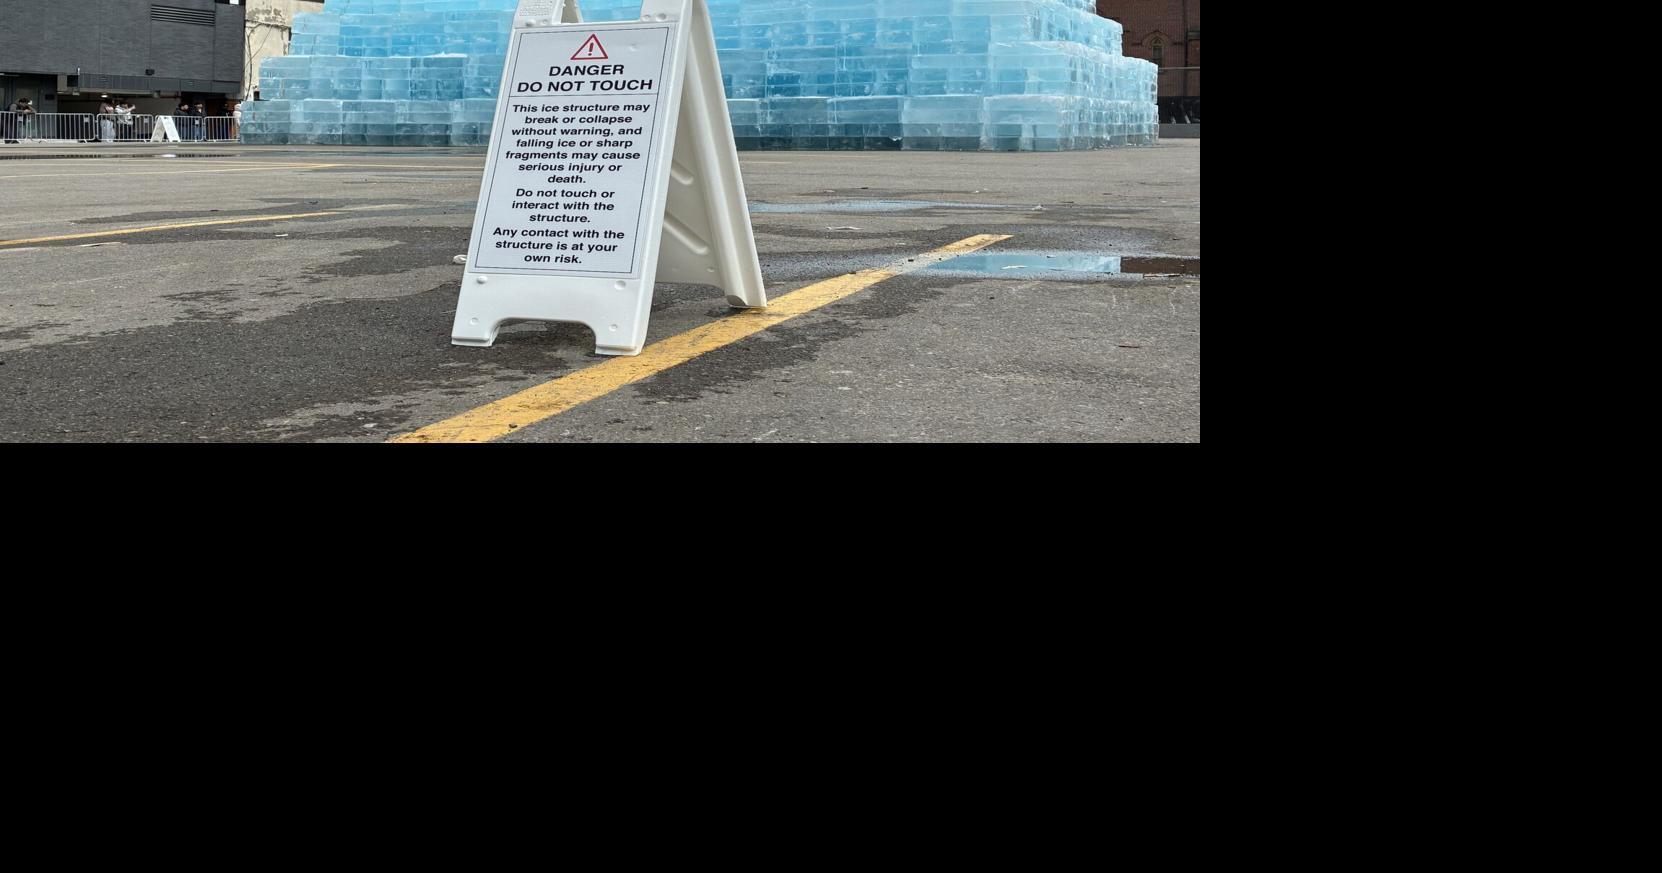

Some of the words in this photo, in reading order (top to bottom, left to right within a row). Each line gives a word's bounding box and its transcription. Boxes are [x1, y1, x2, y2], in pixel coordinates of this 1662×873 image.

[549, 64, 624, 76] DANGER
[517, 81, 542, 92] DO
[547, 81, 585, 92] NOT
[590, 79, 653, 91] TOUCH
[513, 104, 538, 112] This
[541, 104, 559, 112] ice
[563, 104, 620, 112] structure
[623, 104, 650, 113] may
[525, 116, 559, 124] break
[579, 115, 632, 125] collapse
[512, 127, 557, 135] without
[560, 127, 614, 137] warning,
[618, 127, 642, 135] and
[516, 139, 554, 149] falling
[557, 139, 576, 147] ice
[596, 139, 633, 149] sharp
[506, 151, 568, 161] fragments
[571, 153, 598, 161] may
[518, 163, 564, 171] serious
[568, 163, 605, 173] injury
[548, 175, 586, 183] death.
[516, 188, 533, 197] Do
[537, 189, 557, 197] not
[561, 189, 597, 198] touch
[512, 200, 559, 209] interact
[563, 201, 589, 210] with
[594, 202, 614, 211] the
[529, 214, 590, 223] structure.
[493, 227, 518, 238] Any
[521, 229, 569, 237] contact
[573, 229, 599, 238] with
[604, 230, 625, 239] the
[495, 240, 553, 250] structure
[556, 241, 567, 250] is
[571, 243, 584, 251] at
[588, 244, 618, 253] your
[554, 254, 582, 264] risk.
